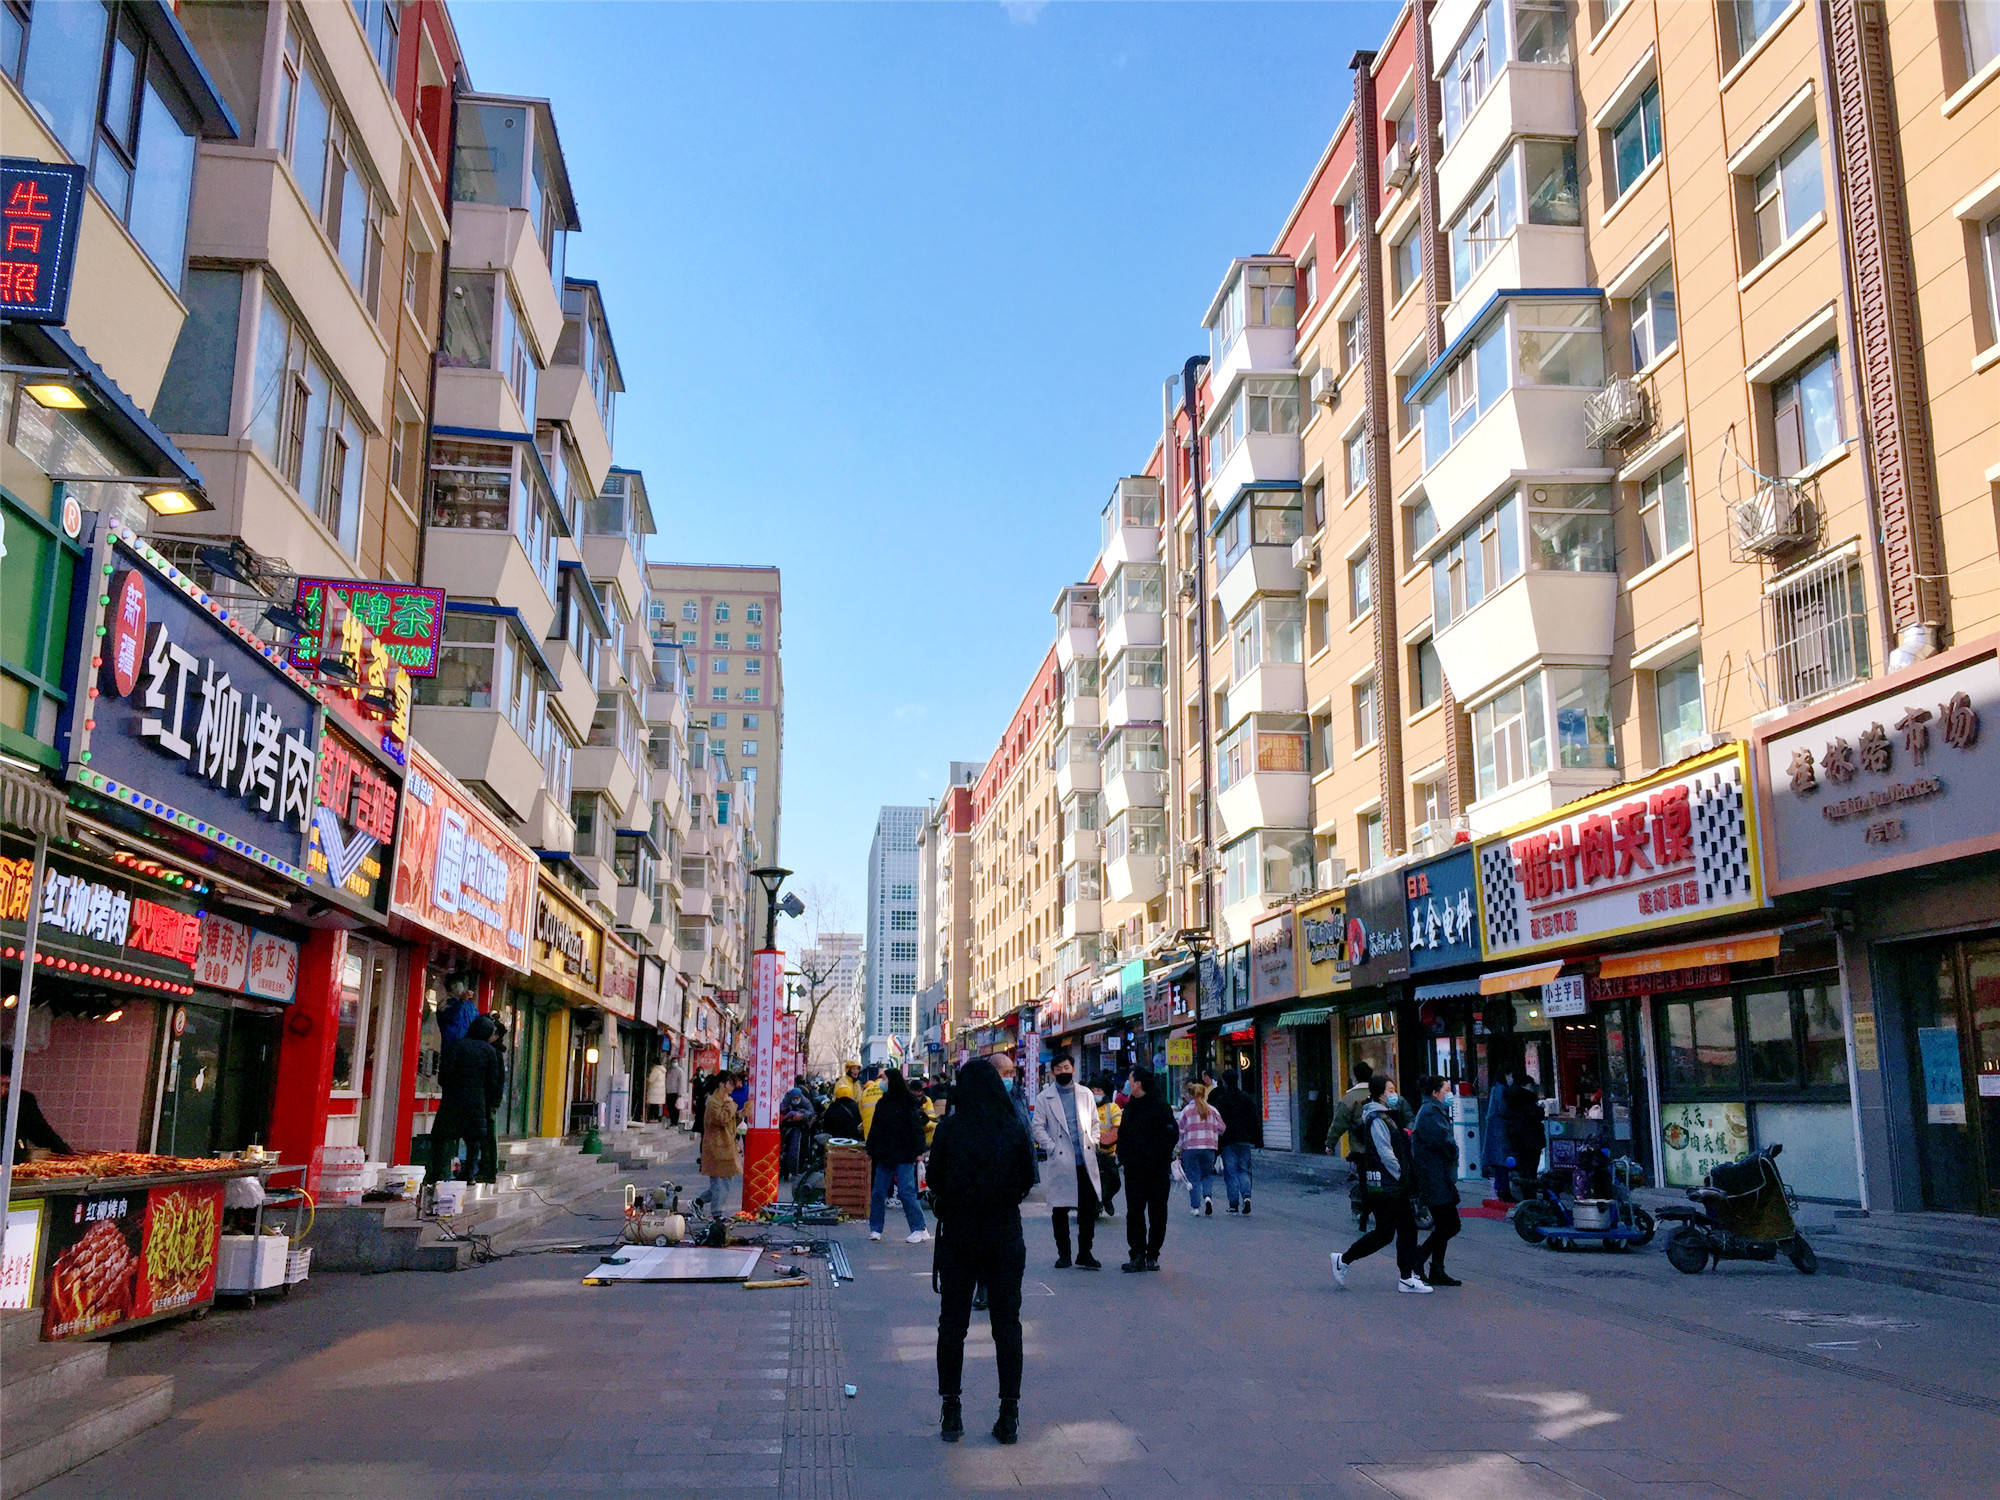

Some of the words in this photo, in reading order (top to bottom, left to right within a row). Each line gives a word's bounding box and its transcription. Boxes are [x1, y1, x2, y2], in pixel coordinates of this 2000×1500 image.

[117, 582, 142, 686] 新疆
[141, 622, 315, 833] 红柳烤肉
[41, 868, 131, 946] 红柳烤肉
[1409, 888, 1473, 951] 五金电料
[1545, 980, 1582, 1004] 小主芋圆
[85, 1197, 128, 1221] 红柳烤肉
